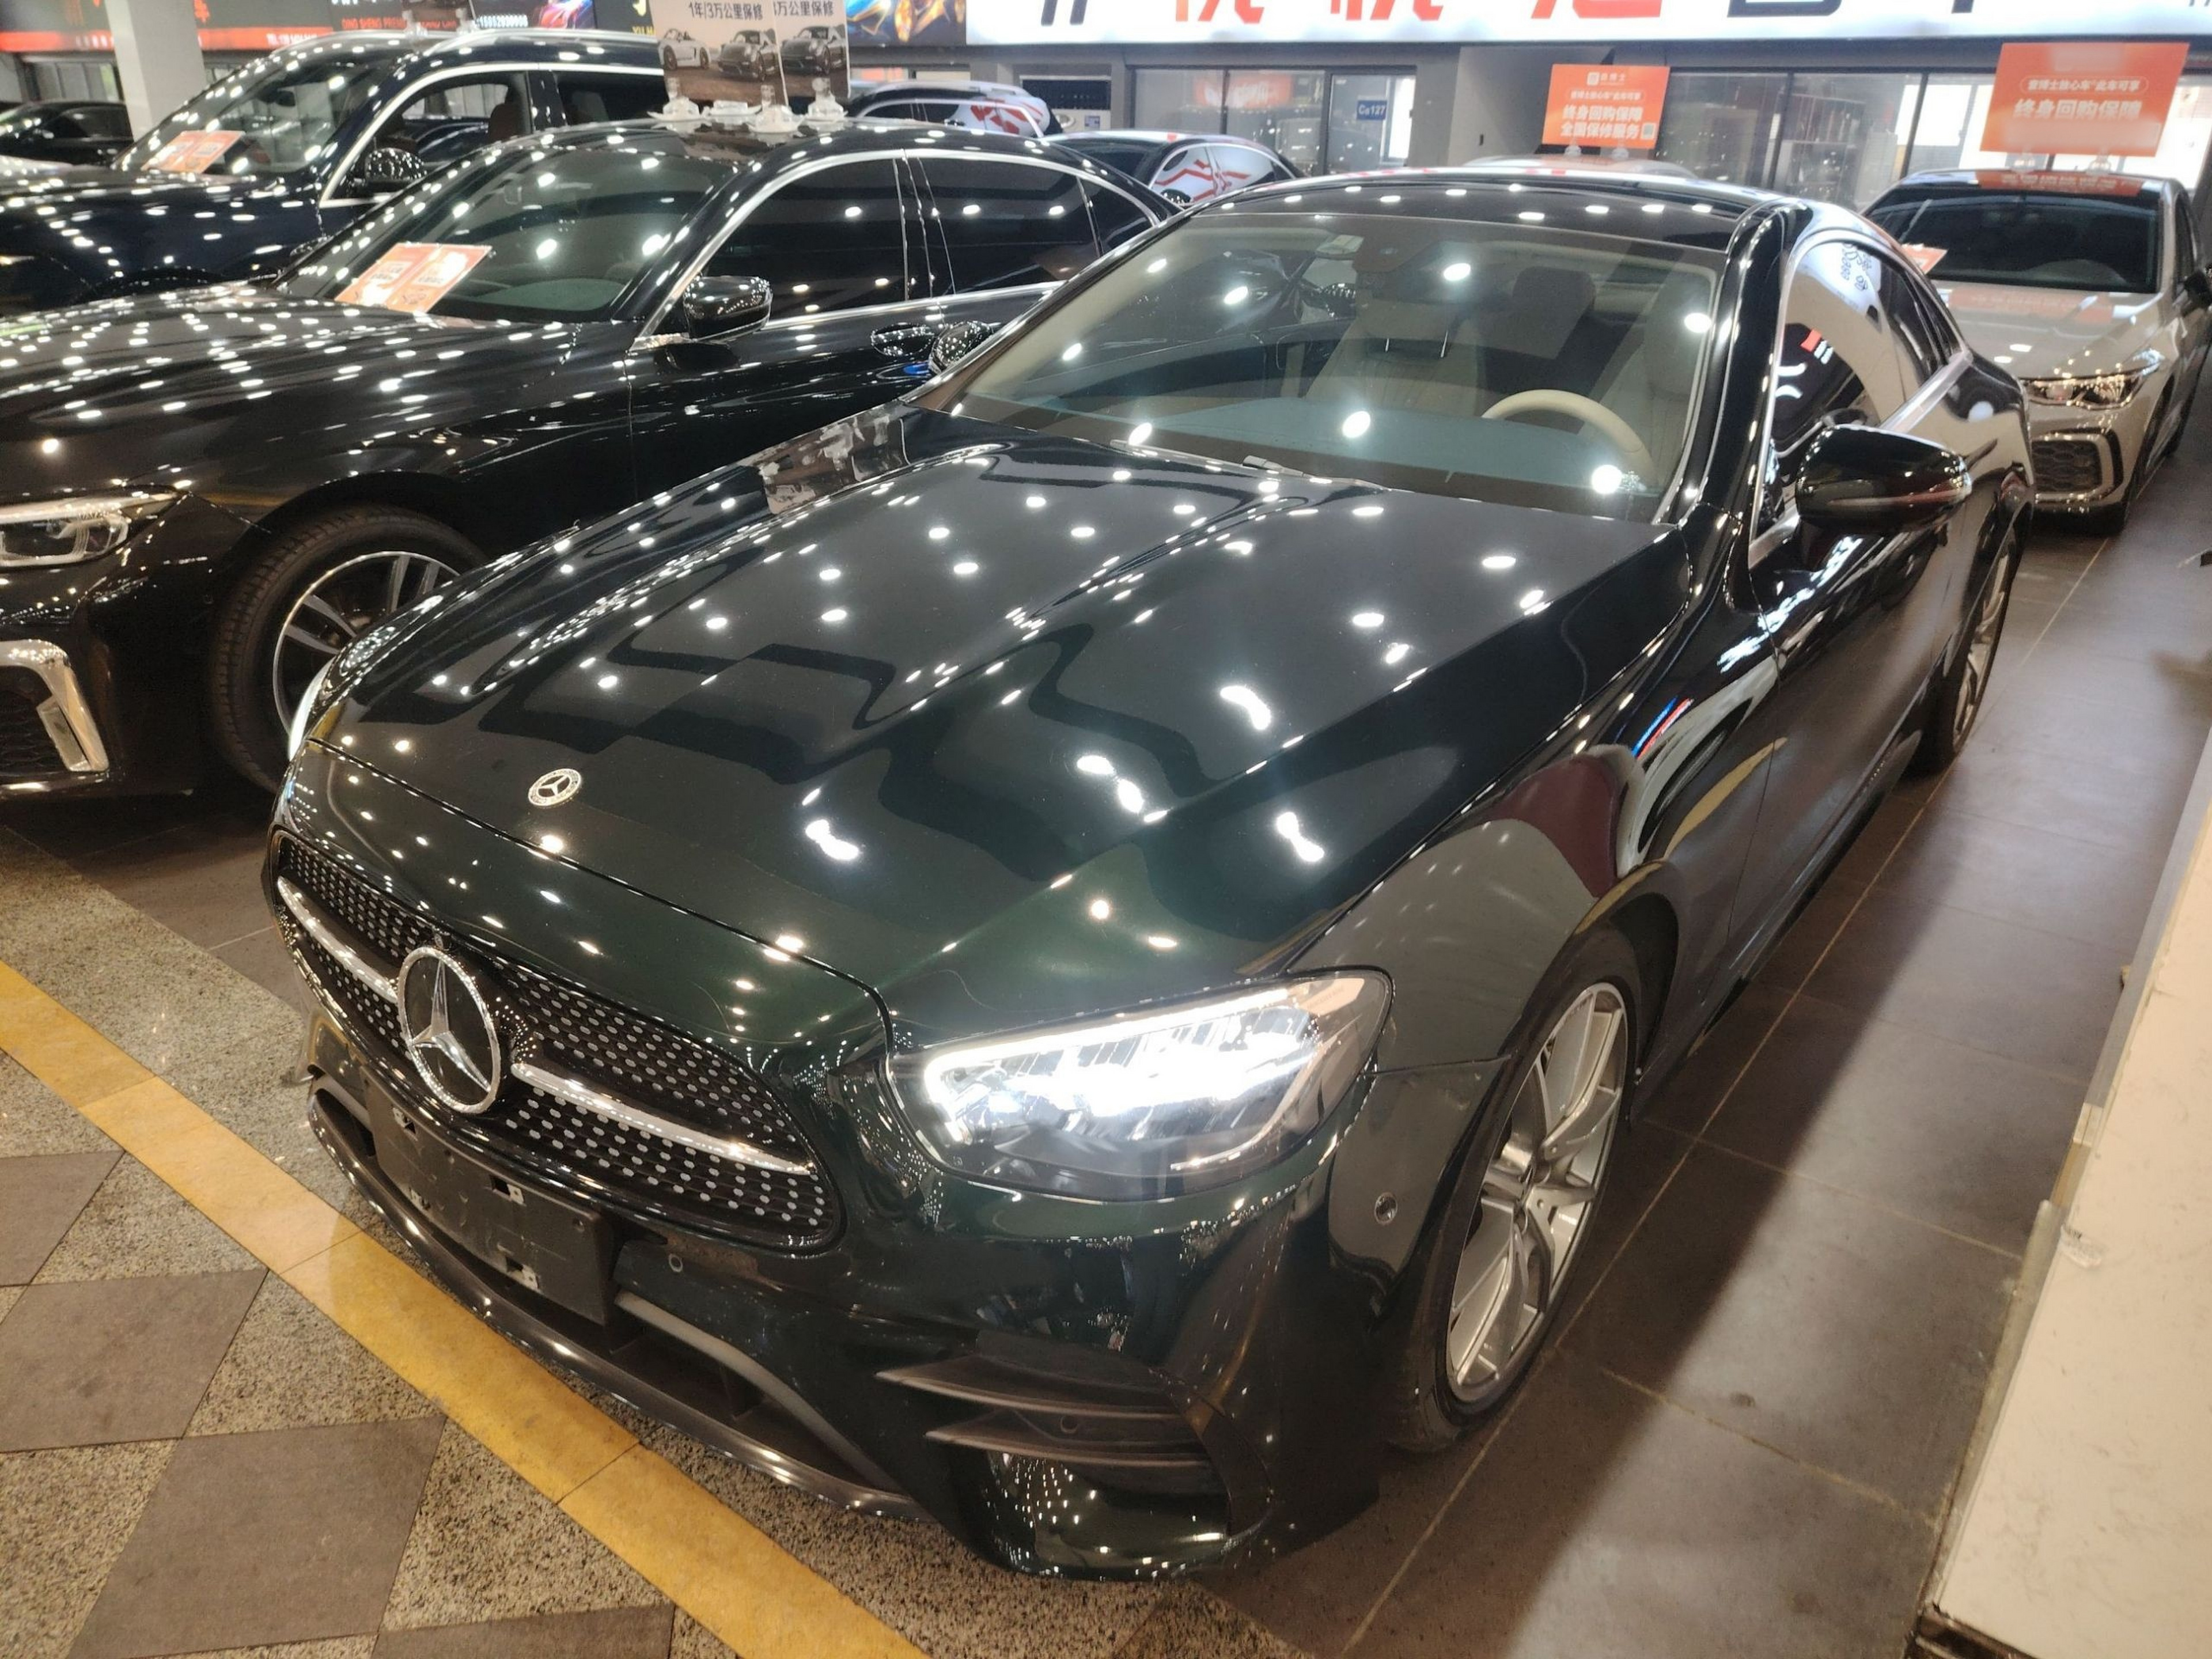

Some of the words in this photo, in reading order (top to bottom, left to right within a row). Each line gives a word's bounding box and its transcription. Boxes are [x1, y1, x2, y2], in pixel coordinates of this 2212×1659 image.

[1562, 104, 1643, 124] 终身回购保障
[2013, 98, 2143, 119] 终身回购保障
[1560, 121, 1640, 139] 全国保修服务
